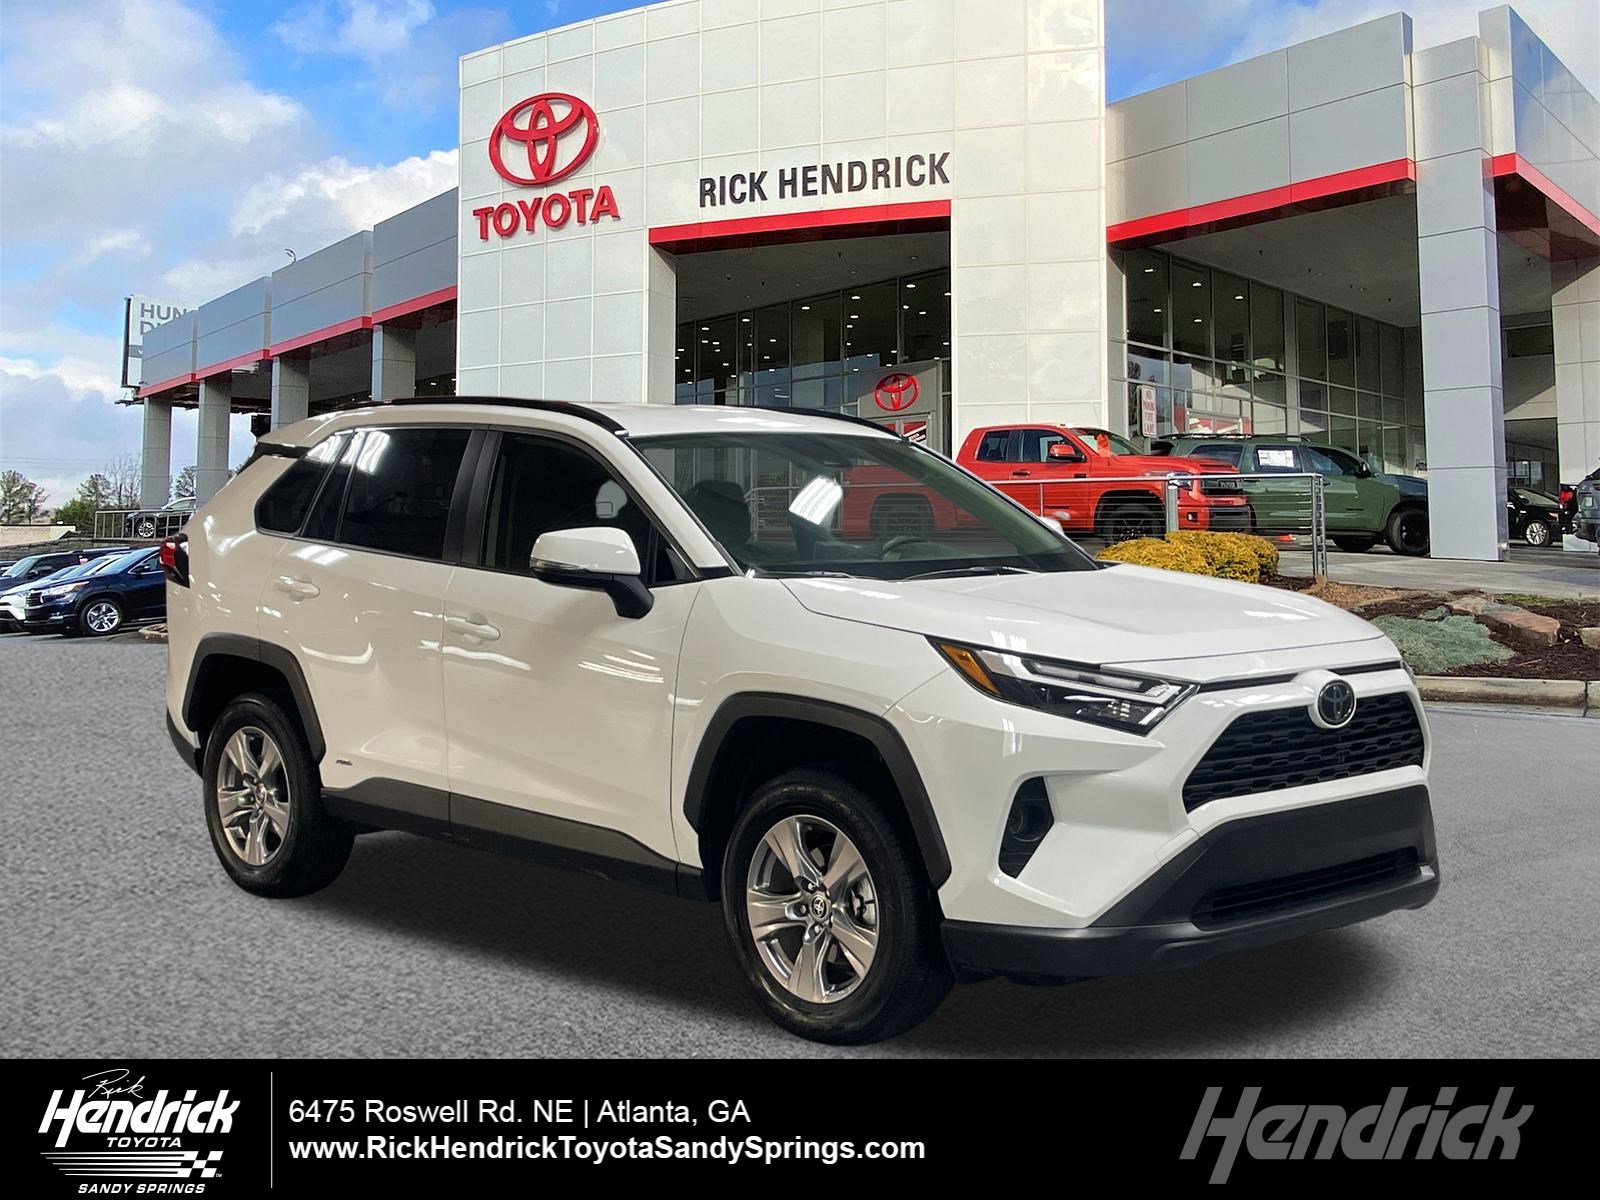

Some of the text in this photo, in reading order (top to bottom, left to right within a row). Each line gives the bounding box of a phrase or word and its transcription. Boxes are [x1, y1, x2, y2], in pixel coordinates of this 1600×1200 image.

[699, 151, 951, 207] RICK HENDRICK
[472, 185, 621, 240] TOYOTA
